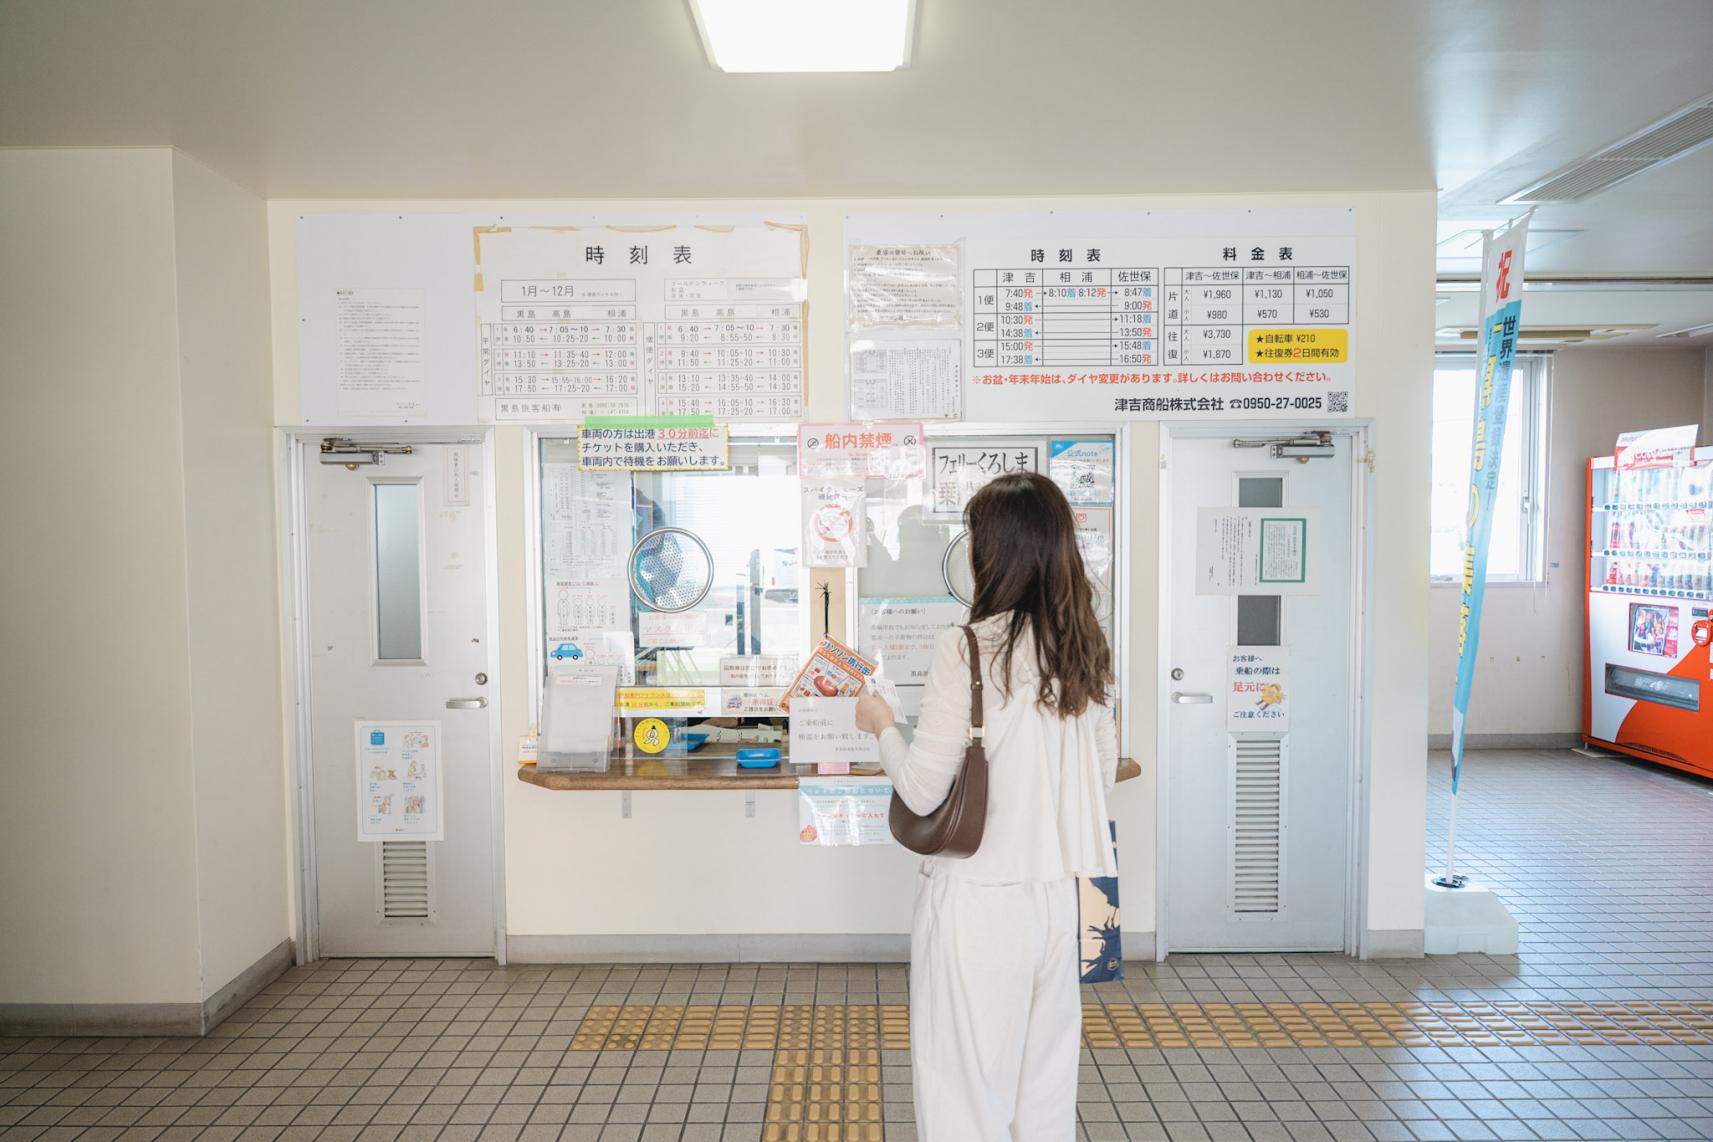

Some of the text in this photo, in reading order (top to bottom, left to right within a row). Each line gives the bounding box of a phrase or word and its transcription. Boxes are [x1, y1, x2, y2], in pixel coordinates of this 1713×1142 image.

[586, 245, 692, 264] 時刻表
[1031, 249, 1101, 262] 時刻表
[1223, 247, 1293, 261] 料金表
[1003, 272, 1151, 283] 津吉 相浦 佐世保
[1186, 270, 1347, 281] 津吉～佐世保 津吉～相浦 相浦～佐世保
[1496, 249, 1513, 303] 祝
[1006, 288, 1152, 298] 7:40発 8:10着 8:12発 8:47着
[1204, 290, 1231, 299] ¥1,960
[1255, 289, 1282, 299] ¥1,130
[1306, 289, 1333, 298] ¥1,050
[978, 295, 994, 305] 1便
[1006, 301, 1152, 312] 9:48着 9:00発
[1001, 314, 1152, 325] 10:30発 11:18着
[1208, 310, 1227, 319] ¥980
[1258, 309, 1277, 319] ¥570
[1310, 309, 1329, 318] ¥530
[977, 322, 994, 332] 2便
[1001, 327, 1152, 338] 14:38着 13:50発
[1203, 329, 1231, 339] ¥3,730
[1296, 334, 1315, 343] ¥210
[1001, 341, 1152, 352] 15:00発 15:48着
[977, 349, 994, 358] 3便
[1203, 350, 1231, 359] ¥1,870
[1001, 354, 1152, 365] 17:38着 16:50発
[1115, 397, 1322, 411] 津吉商船株式会社 0950-27-0025
[824, 432, 893, 448] 船内禁煙
[582, 443, 704, 453] チケットを購入いただき、
[582, 456, 725, 466] 車両内で待機をお願いします。
[1233, 682, 1265, 692] 足元に
